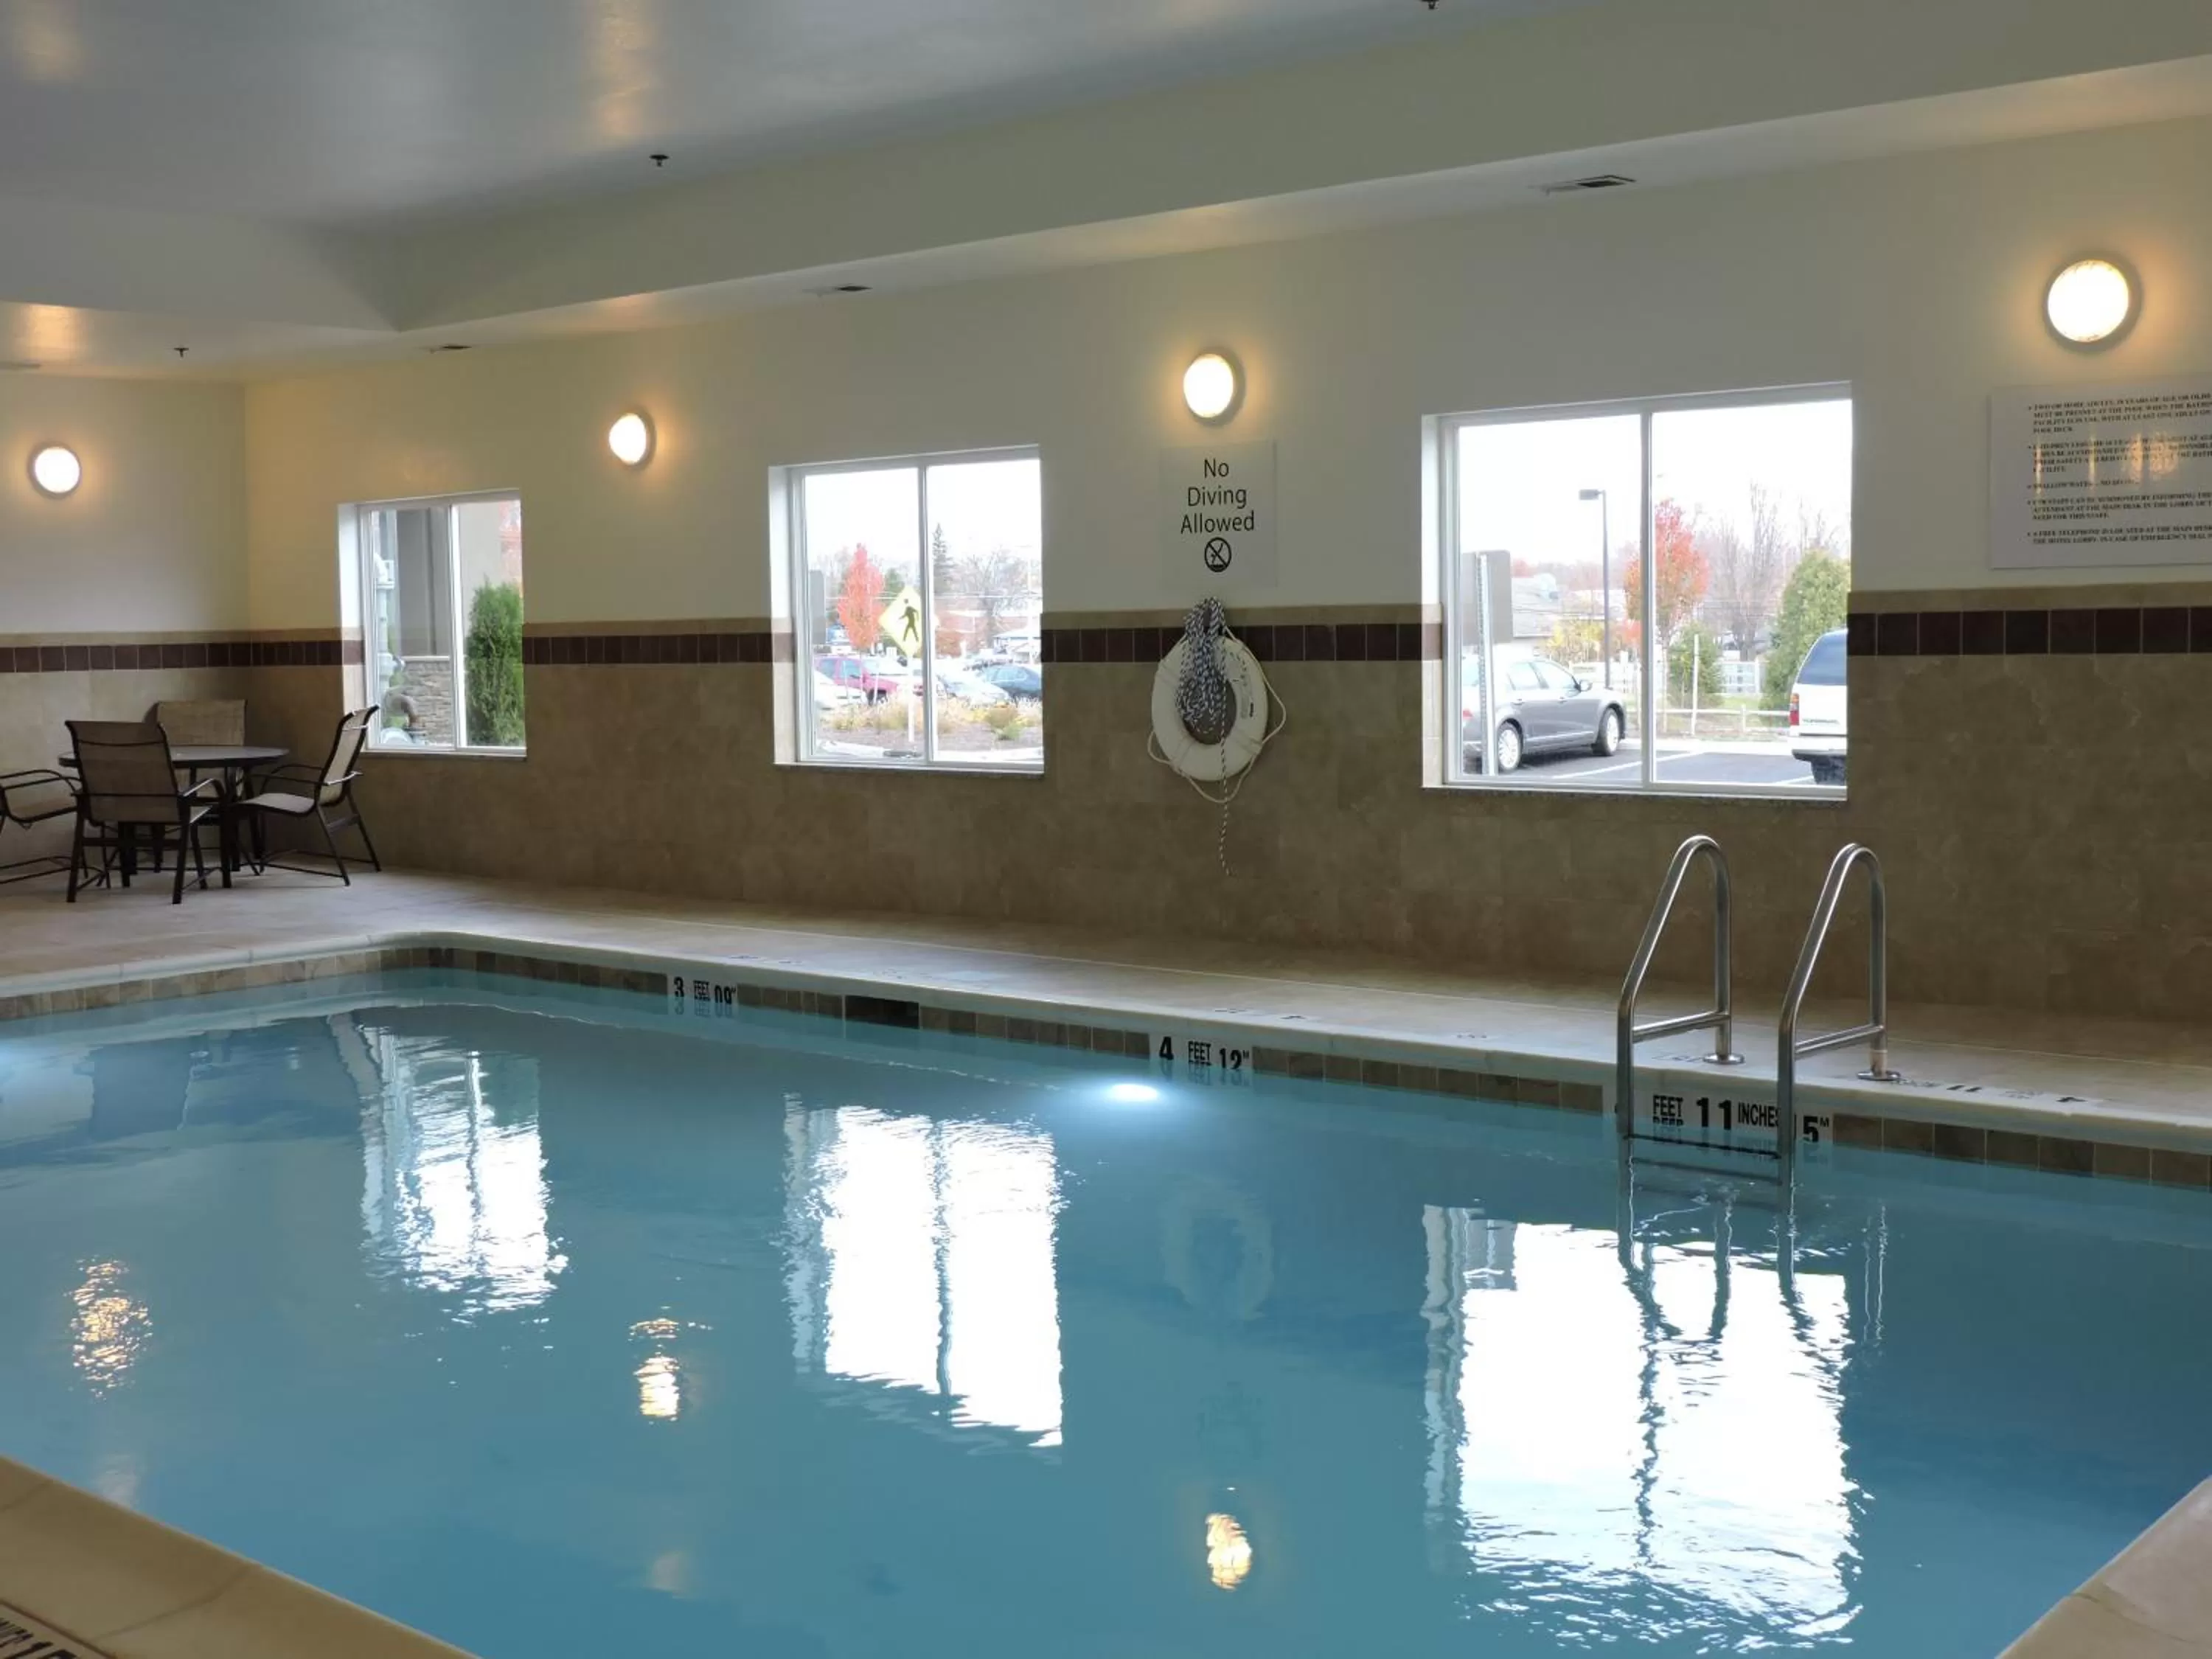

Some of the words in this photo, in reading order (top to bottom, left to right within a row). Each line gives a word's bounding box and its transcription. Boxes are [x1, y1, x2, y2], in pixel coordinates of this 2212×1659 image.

[1203, 458, 1230, 479] No
[1187, 485, 1247, 509] Diving
[1180, 510, 1255, 535] Allowed
[1159, 1036, 1174, 1060] 4
[1188, 1040, 1211, 1062] FEET
[1652, 1095, 1683, 1117] FEET
